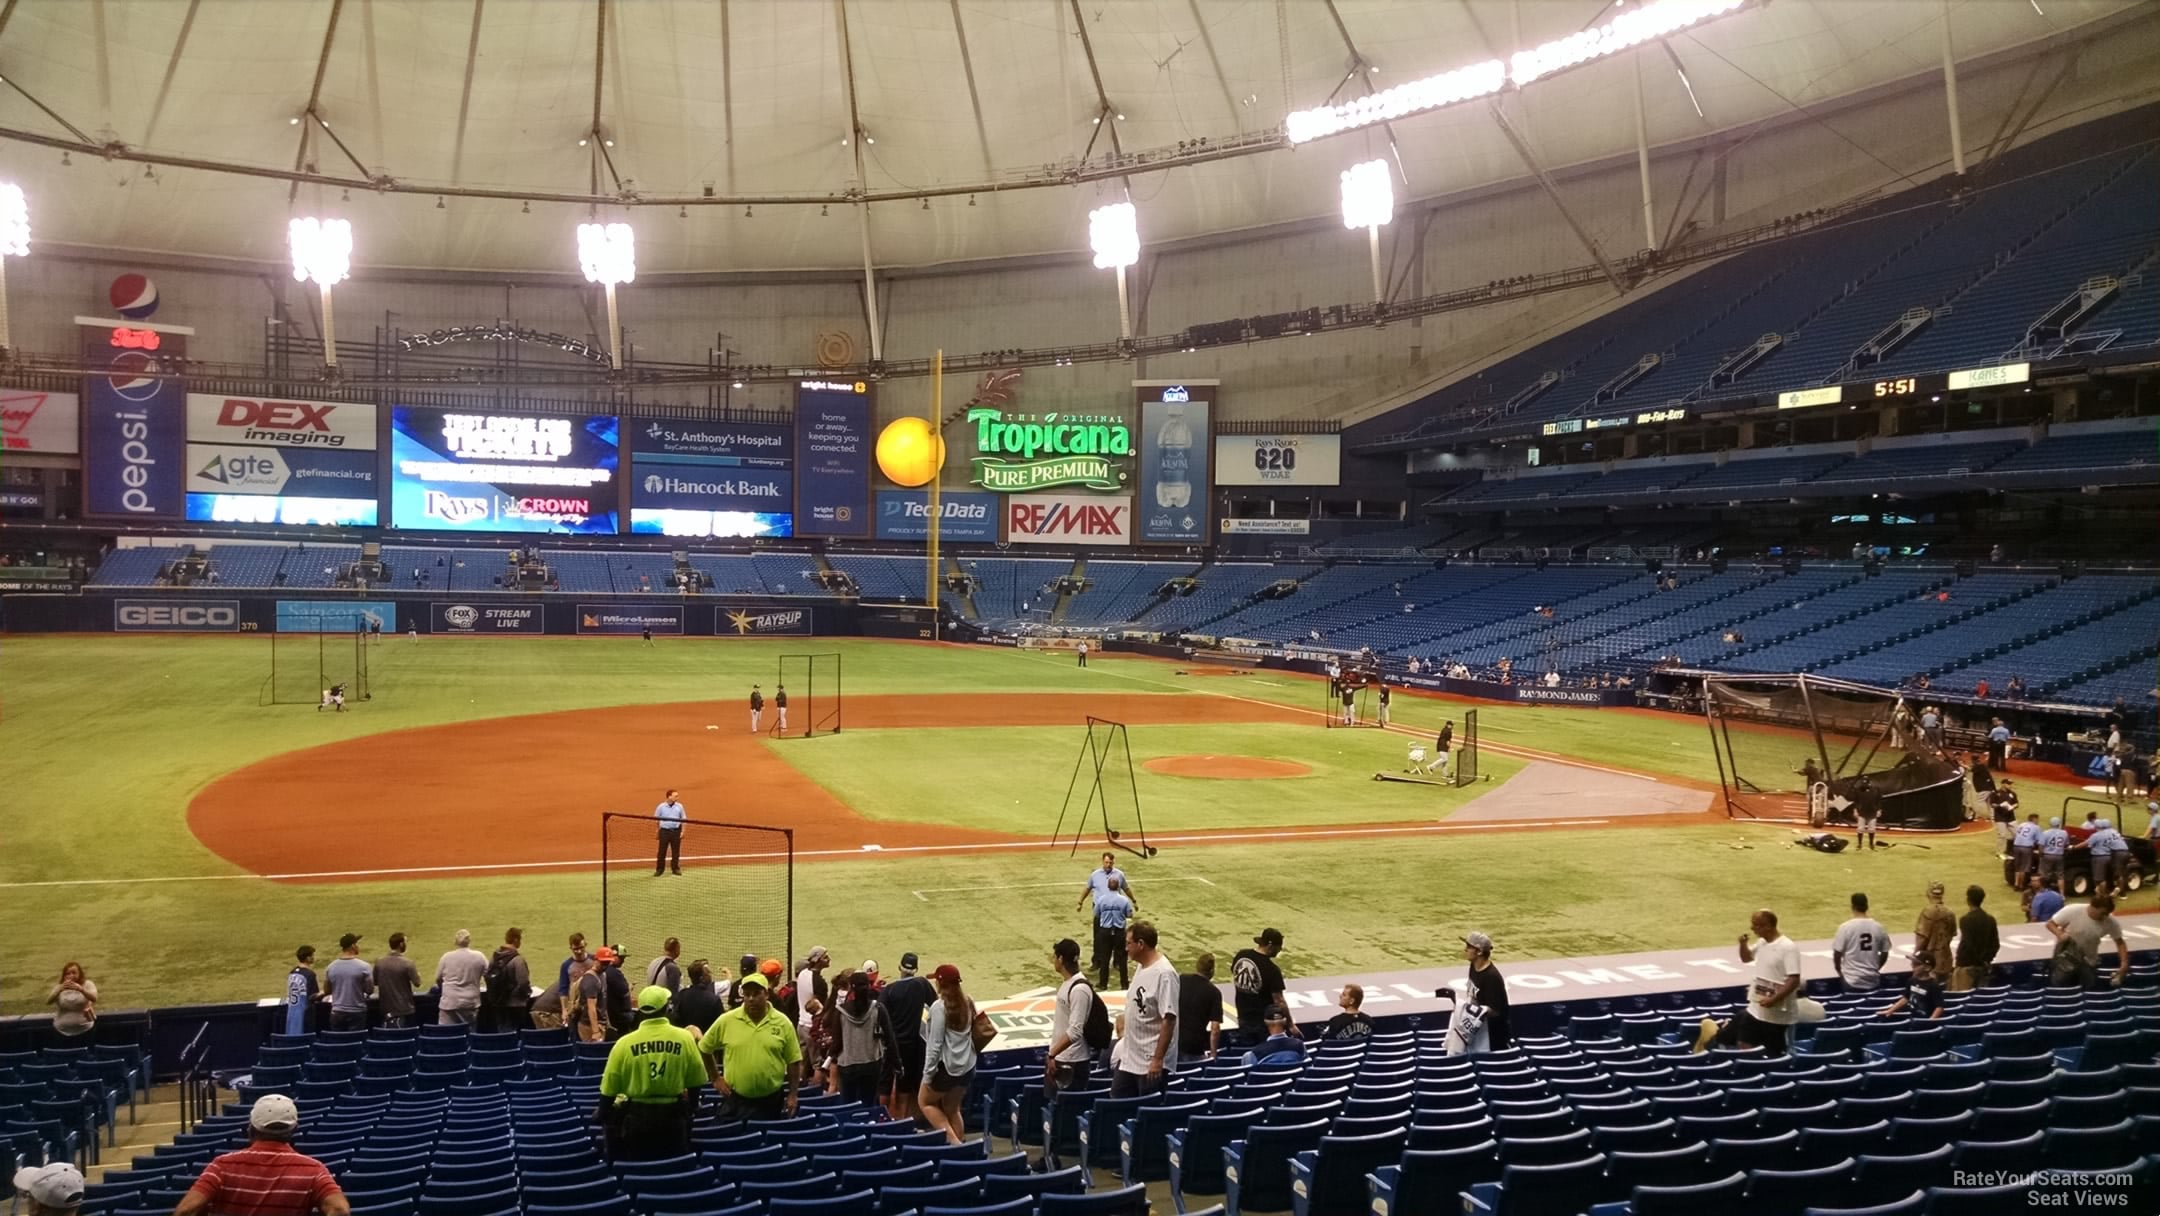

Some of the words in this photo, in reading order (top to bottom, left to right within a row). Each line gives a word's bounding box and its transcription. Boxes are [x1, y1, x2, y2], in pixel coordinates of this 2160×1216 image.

[1875, 378, 1915, 397] 5:51
[216, 399, 337, 432] DEX
[822, 412, 846, 422] home
[1007, 414, 1035, 422] THE
[1063, 415, 1123, 423] ORIGINAL
[244, 427, 345, 446] imaging
[664, 431, 679, 441] St.
[681, 431, 735, 447] Anthony's
[737, 434, 782, 447] Hospital
[808, 432, 843, 444] keeping
[844, 435, 860, 443] you
[967, 409, 1129, 458] Tropicana
[664, 443, 689, 452] BayCare
[689, 444, 709, 452] Health
[709, 445, 731, 453] System
[810, 444, 857, 453] connected.
[115, 412, 155, 512] pepsi
[228, 455, 274, 479] gte
[1255, 447, 1296, 470] 620
[295, 468, 372, 481] gtefinancial.org
[984, 466, 1027, 486] PURE
[1031, 461, 1108, 484] PREMIUM
[1260, 471, 1291, 479] WDAE
[665, 478, 737, 495] Hancock
[738, 480, 782, 496] Bank
[519, 497, 589, 513] CROWN
[943, 502, 988, 519] Data
[1011, 503, 1122, 535] RE/MAX
[35, 583, 51, 591] THE
[119, 606, 234, 625] GEICO
[288, 604, 355, 625] Sagicor
[452, 609, 471, 618] FOX
[484, 609, 532, 618] STREAM
[241, 622, 258, 631] 370
[496, 618, 520, 628] LIVE
[919, 629, 931, 637] 322
[1519, 689, 1568, 700] RAYMOND
[2048, 837, 2065, 848] 42
[1859, 933, 1873, 951] 2
[1283, 961, 1686, 1009] WELOME
[630, 1040, 683, 1057] VENDOR
[649, 1060, 667, 1079] 34
